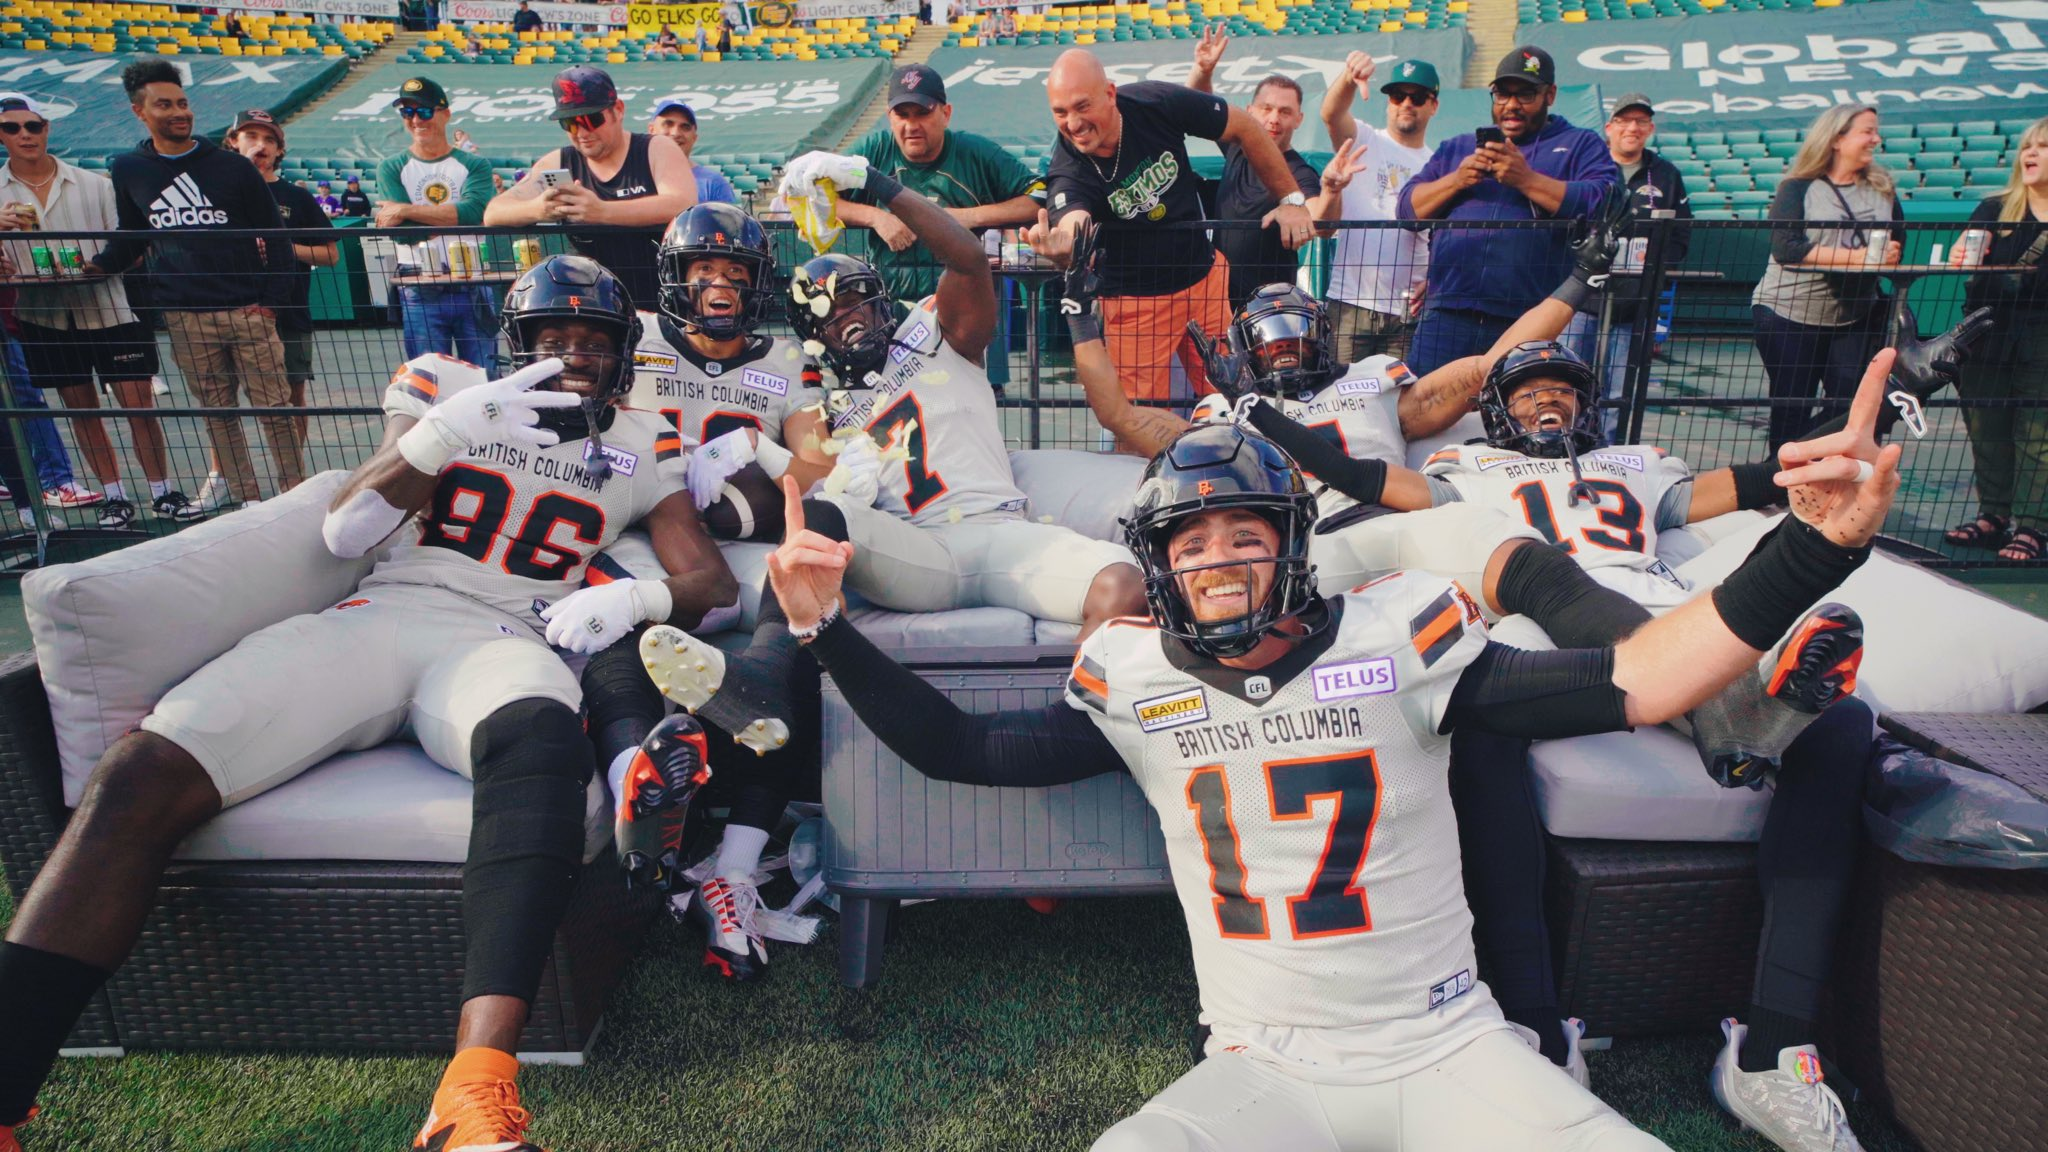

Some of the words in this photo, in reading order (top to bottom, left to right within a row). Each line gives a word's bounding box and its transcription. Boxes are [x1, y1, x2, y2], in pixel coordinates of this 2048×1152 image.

[285, 1, 321, 10] LIGHT
[356, 4, 391, 14] ZONE
[454, 4, 495, 20] Coors
[567, 11, 601, 22] ZONE
[630, 9, 652, 25] GO
[657, 7, 697, 25] ELKS
[808, 5, 843, 18] LIGHT
[1577, 22, 2046, 71] Global
[1108, 151, 1179, 217] ESKIMOS
[149, 206, 229, 229] adidas
[746, 372, 785, 391] TELUS
[1340, 382, 1378, 392] TELUS
[656, 377, 705, 400] BRITISH
[711, 385, 769, 413] COLUMBIA
[485, 402, 498, 420] CFL
[1308, 398, 1366, 416] COLUMBIA
[863, 390, 950, 515] 7
[1598, 454, 1640, 467] TELUS
[1505, 462, 1559, 479] BRITISH
[417, 462, 606, 582] 96
[1510, 478, 1646, 555] 13
[588, 617, 603, 634] CFL
[1249, 683, 1268, 693] CFL
[1318, 667, 1389, 692] TELUS
[1142, 698, 1199, 719] LEAVITT
[1174, 721, 1254, 758] BRITISH
[1262, 707, 1362, 744] COLUMBIA
[1184, 748, 1383, 940] 17
